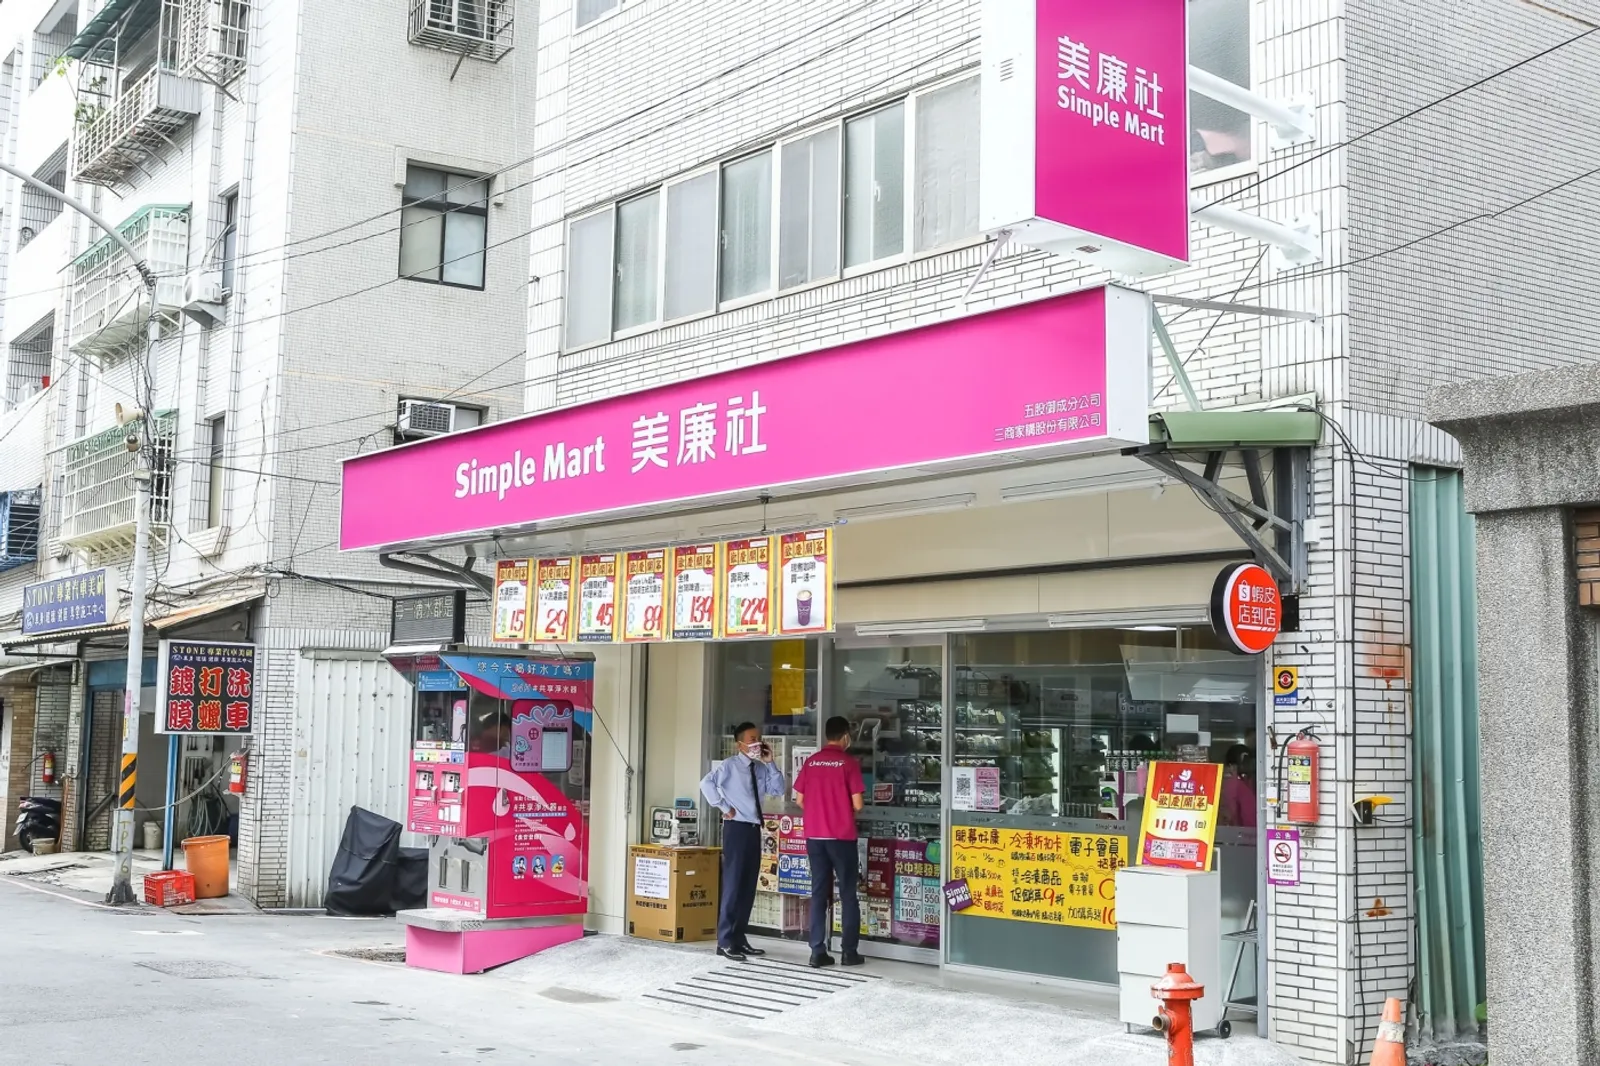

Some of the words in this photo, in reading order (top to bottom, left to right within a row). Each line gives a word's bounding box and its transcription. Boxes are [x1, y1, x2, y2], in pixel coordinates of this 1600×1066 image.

[1057, 35, 1165, 120] 美廉社
[1057, 84, 1120, 128] Simple
[1124, 110, 1165, 146] Mart
[1024, 393, 1101, 419] 五股御成分公司
[994, 413, 1101, 442] 三商家購股份有限公司
[454, 449, 536, 502] Simple
[542, 436, 606, 483] Mart
[630, 390, 768, 475] 美廉社
[26, 585, 55, 608] STONE
[1251, 585, 1277, 605] 蝦皮
[510, 609, 526, 632] 15
[596, 603, 614, 627] 45
[644, 604, 663, 632] 89
[690, 595, 714, 623] 139
[1238, 604, 1277, 626] 店到店
[545, 608, 569, 635] 29
[172, 645, 206, 655] STONE
[477, 661, 581, 677] 您今天喝好水了嗎?
[197, 666, 224, 731] 打蠟
[226, 667, 252, 731] 洗車
[1158, 795, 1206, 808] 歡慶開幕
[955, 828, 1000, 845] 開幕好康
[1155, 818, 1189, 832] 11/18
[1009, 831, 1062, 852] 冷凍折扣卡
[1069, 837, 1119, 857] 電子會員
[1097, 857, 1126, 870] 招募中
